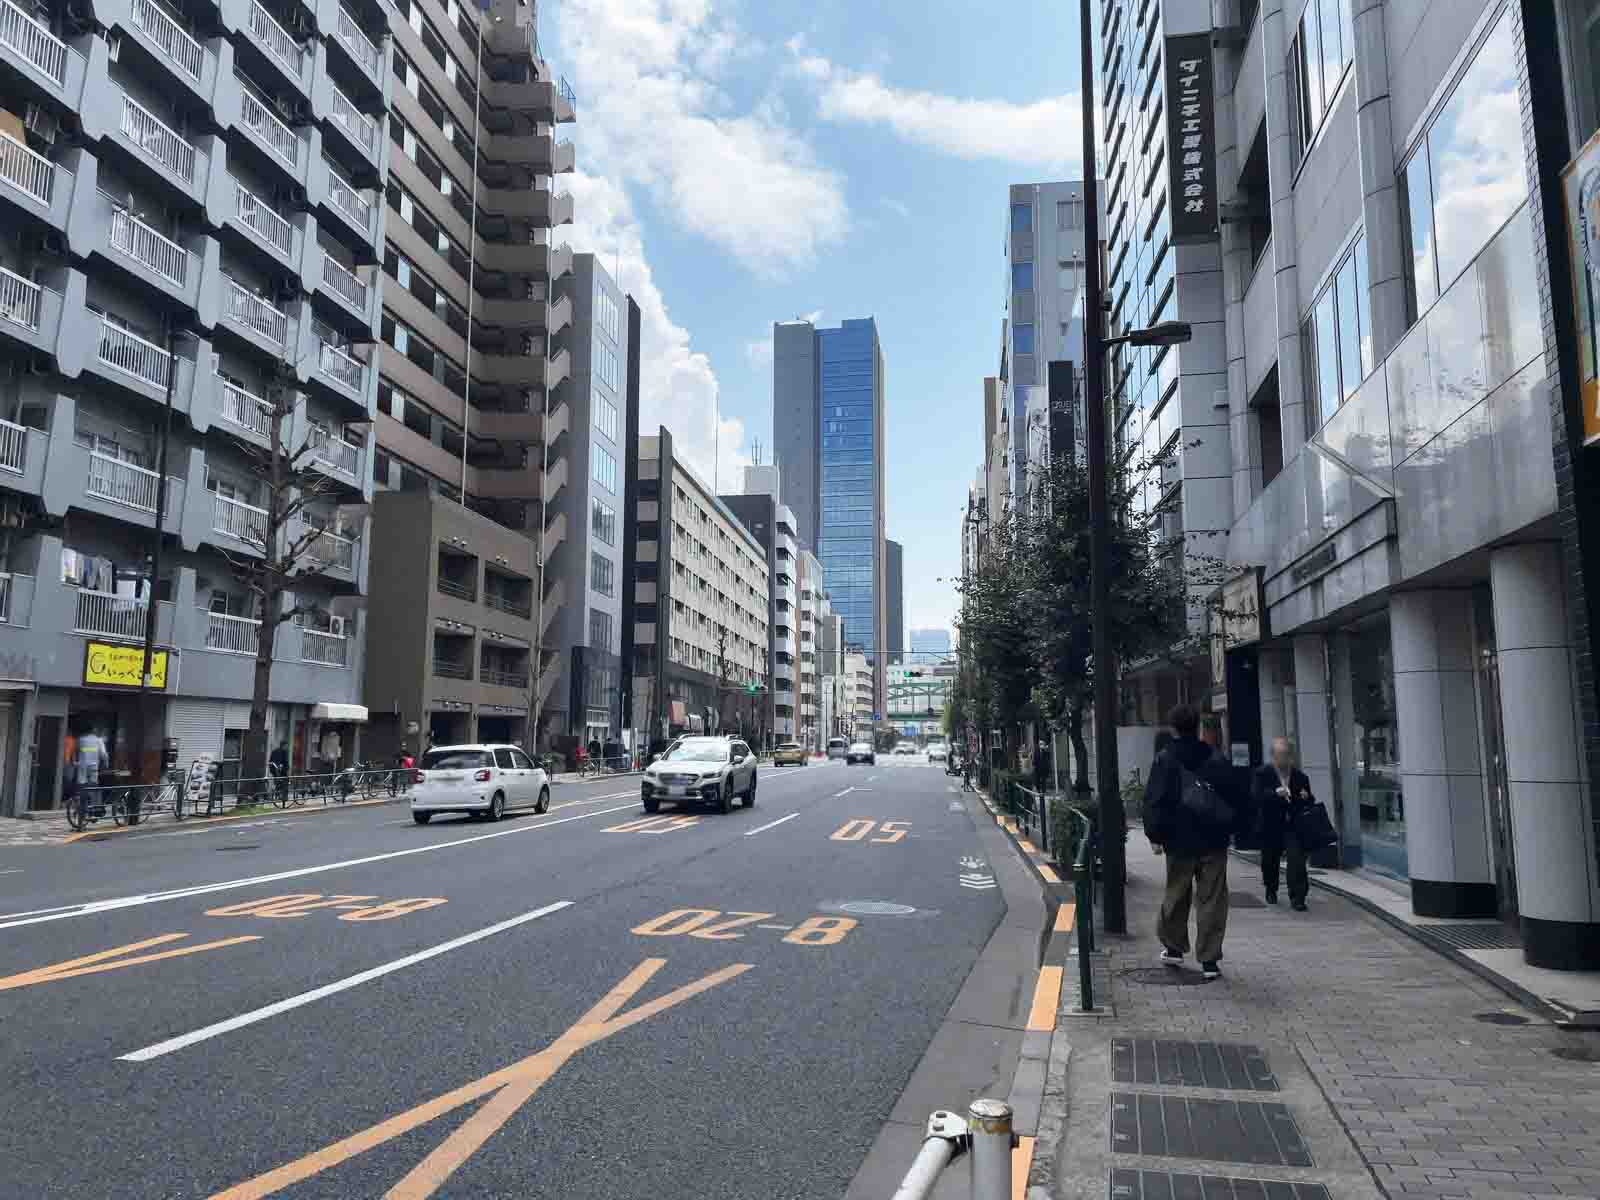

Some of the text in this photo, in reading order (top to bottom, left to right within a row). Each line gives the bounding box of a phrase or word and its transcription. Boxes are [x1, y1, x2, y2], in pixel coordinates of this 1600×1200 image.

[107, 666, 163, 681] いっぺこぺ
[829, 819, 913, 843] 50
[630, 908, 860, 945] 8-20
